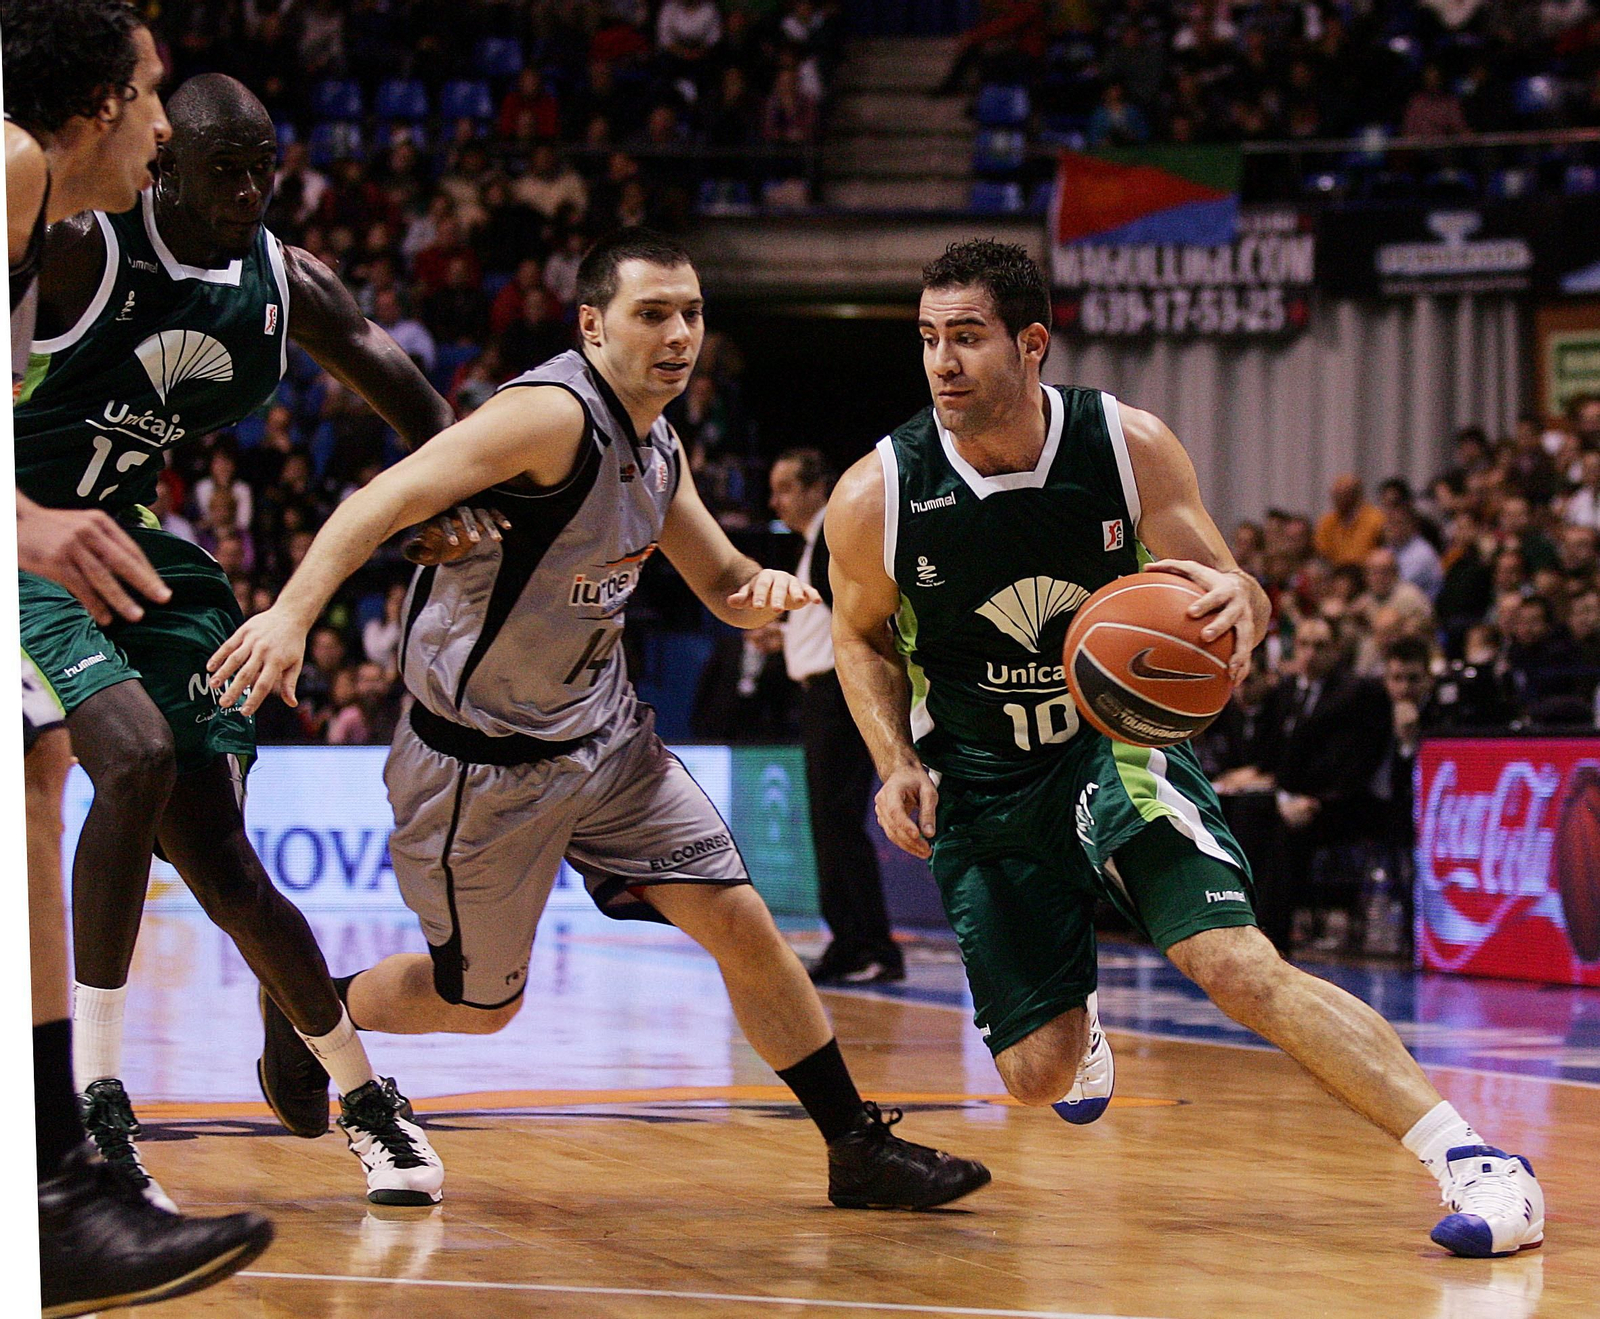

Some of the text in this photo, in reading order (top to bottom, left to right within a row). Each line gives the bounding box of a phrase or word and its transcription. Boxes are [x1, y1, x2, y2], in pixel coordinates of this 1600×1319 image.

[103, 400, 186, 445] Unicaja
[910, 491, 956, 514] hummel
[64, 652, 107, 678] hummel
[1003, 694, 1080, 751] 10
[650, 834, 730, 871] EL CORREO
